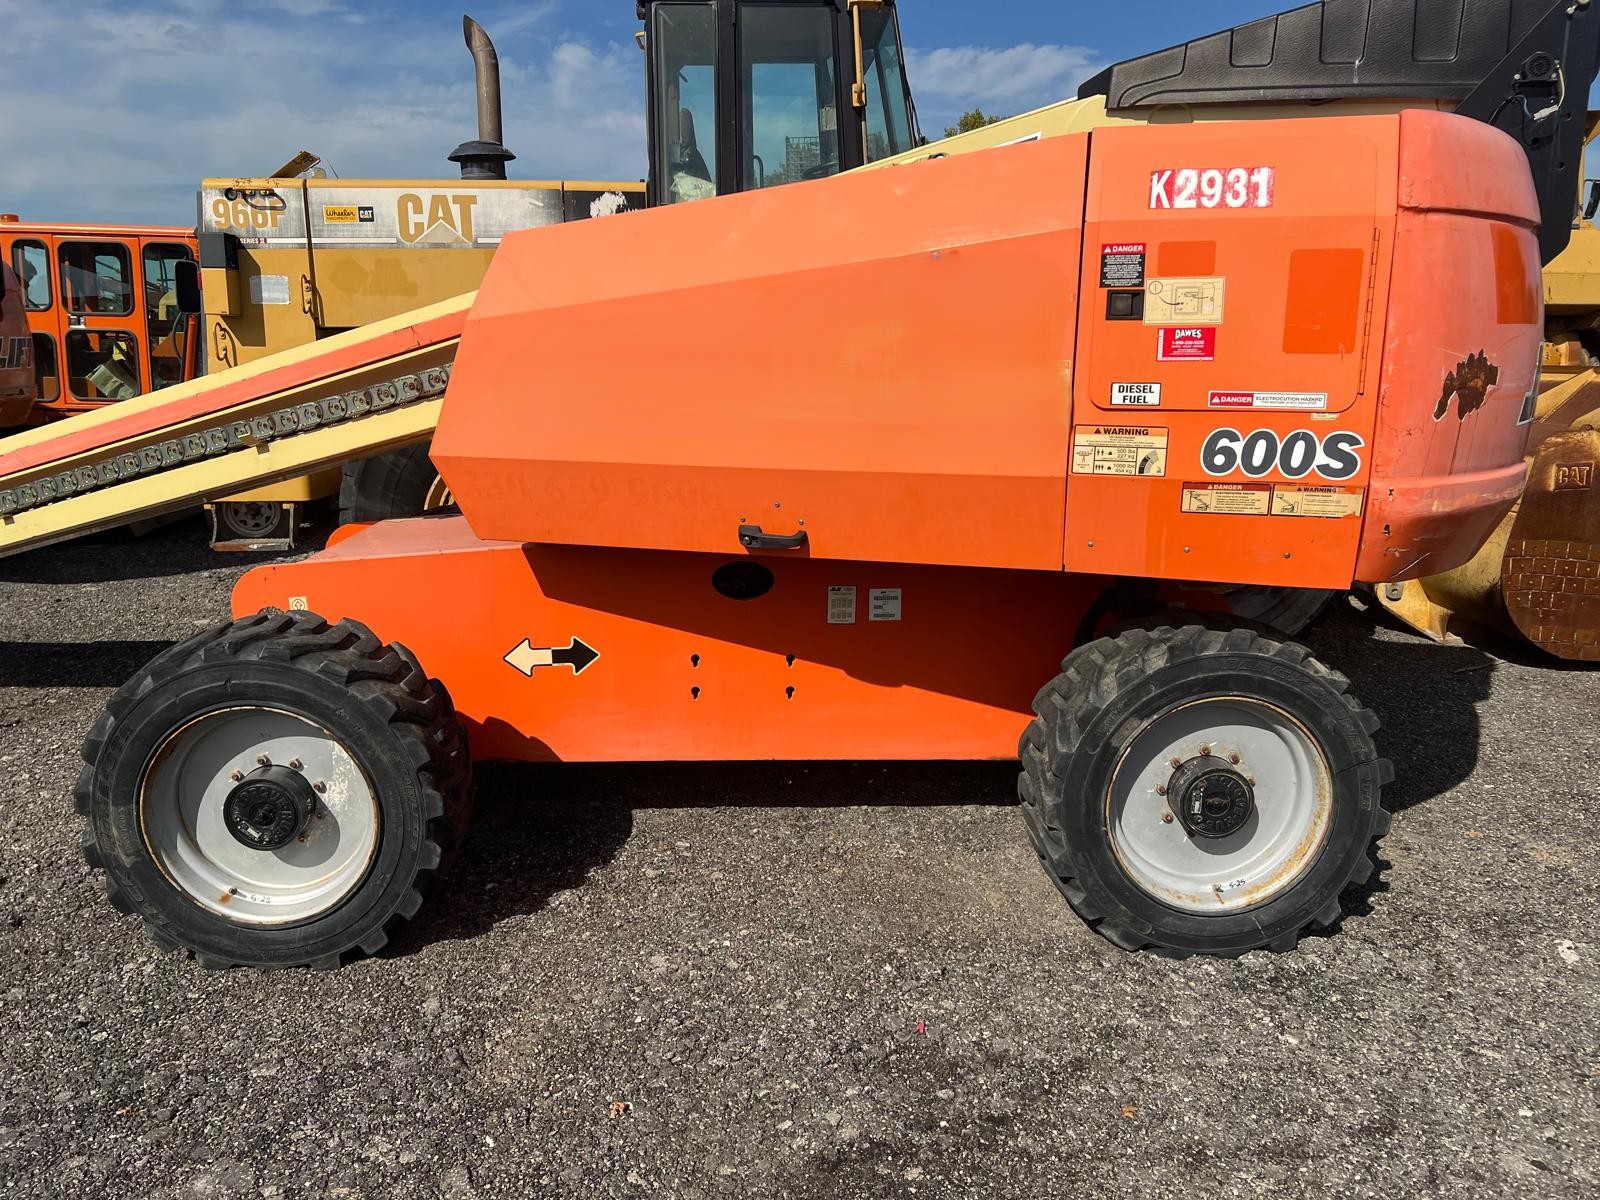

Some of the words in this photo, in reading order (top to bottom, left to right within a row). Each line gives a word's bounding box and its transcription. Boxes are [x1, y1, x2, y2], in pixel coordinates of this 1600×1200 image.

[1149, 167, 1273, 209] K2931
[212, 197, 287, 230] 966F
[359, 210, 373, 219] CAT
[397, 192, 478, 244] CAT
[1112, 245, 1144, 253] DANGER
[1175, 328, 1202, 339] DAWES
[1118, 384, 1155, 394] DIESEL
[1122, 395, 1149, 404] FUEL
[1220, 396, 1253, 404] DANGER
[1103, 427, 1149, 436] WARNING
[1200, 427, 1365, 480] 600S
[1558, 466, 1590, 486] CAT
